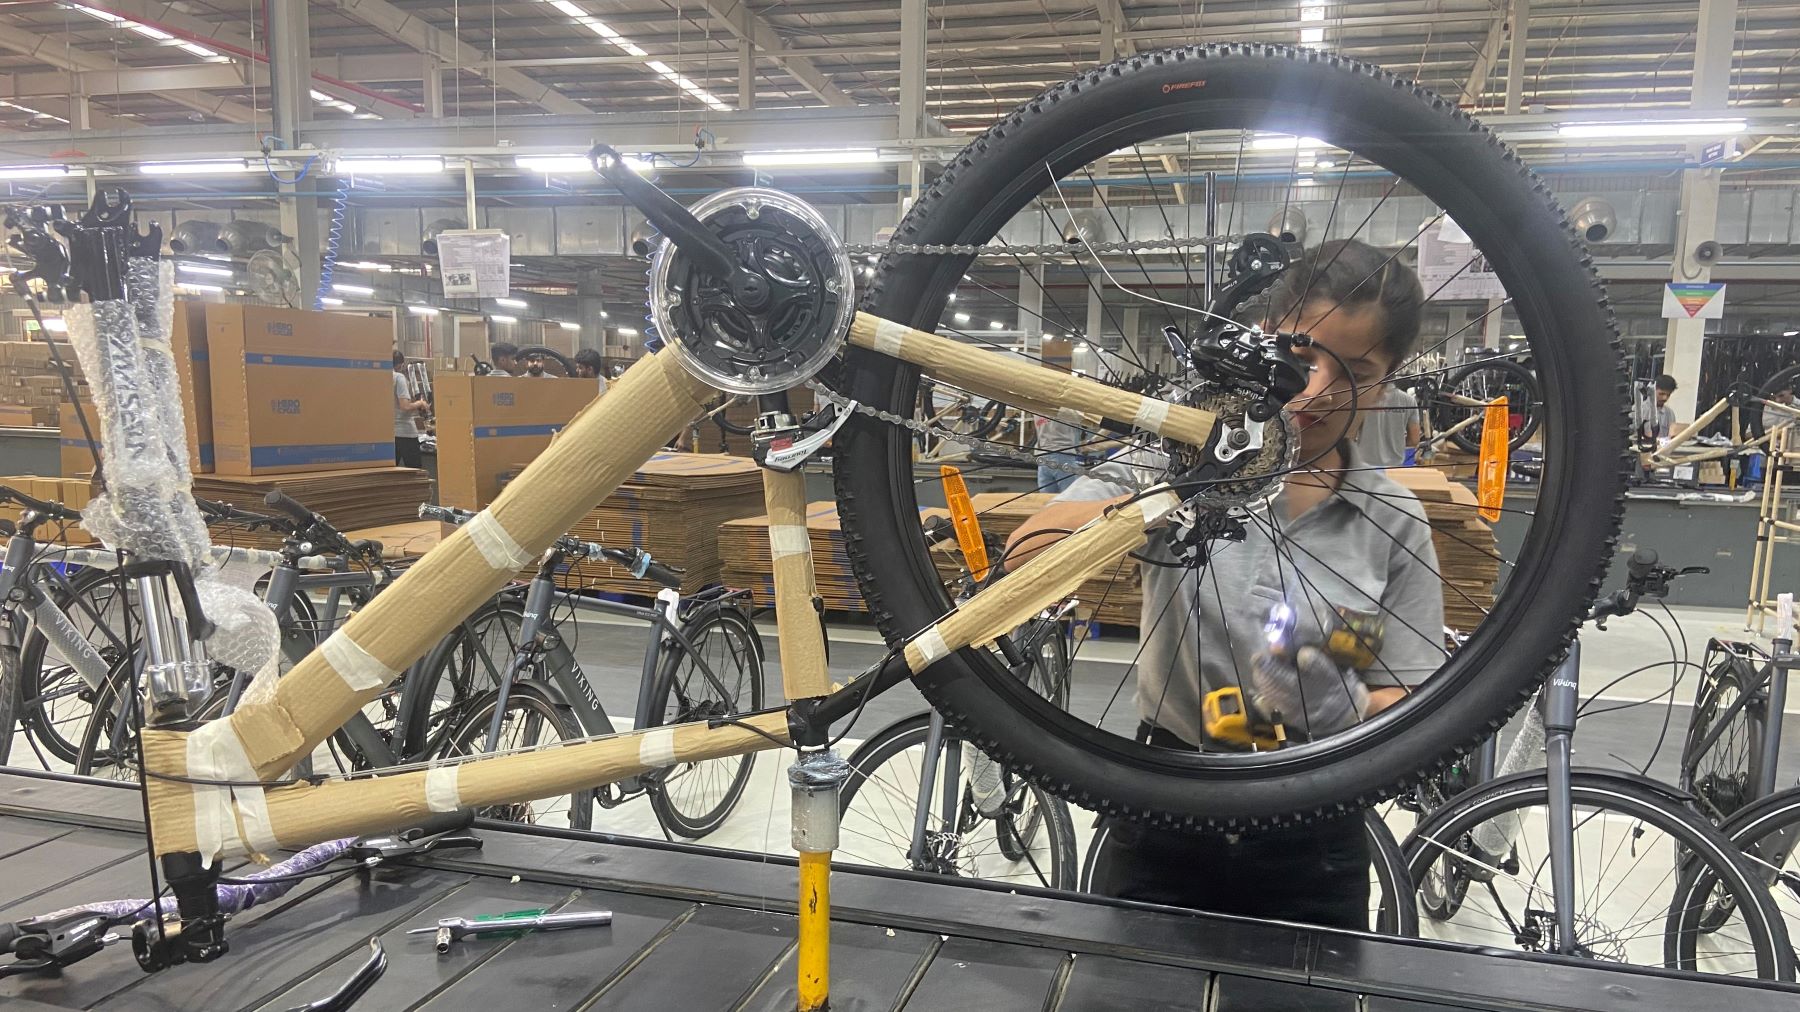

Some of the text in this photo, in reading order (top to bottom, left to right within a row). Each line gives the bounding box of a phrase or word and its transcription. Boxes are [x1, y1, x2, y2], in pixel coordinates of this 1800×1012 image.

[55, 615, 92, 659] VIKING
[571, 661, 600, 711] VIKING
[1553, 678, 1577, 691] Viking
